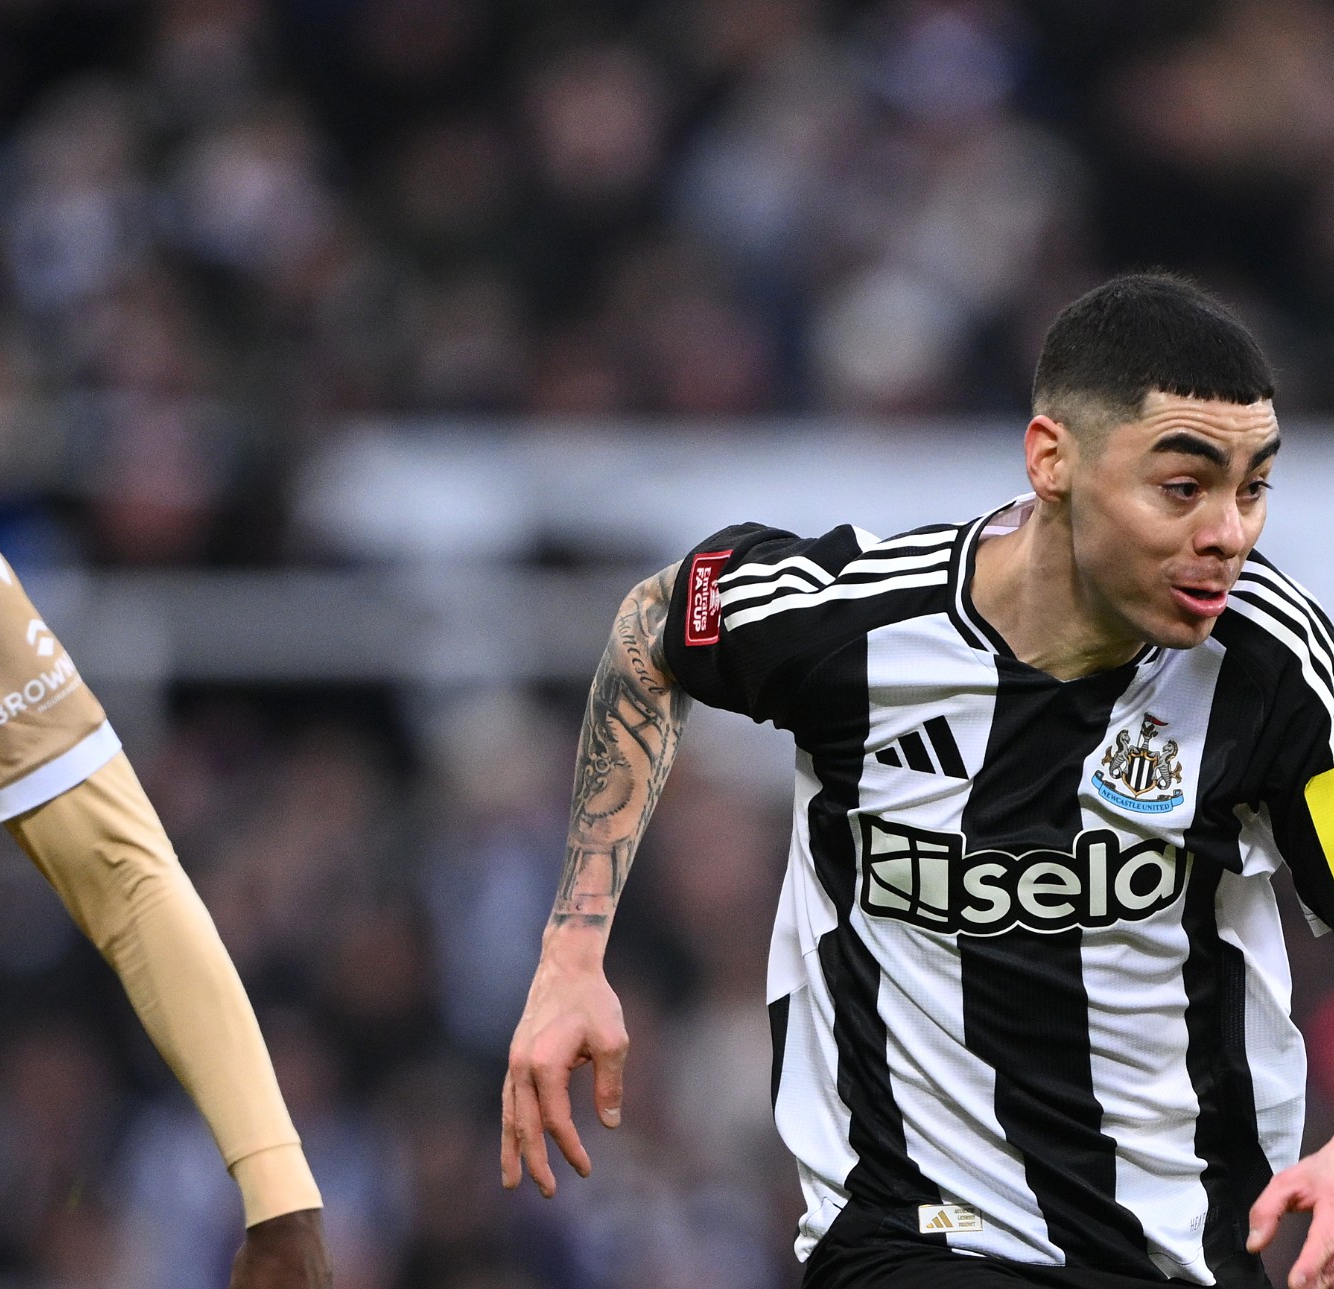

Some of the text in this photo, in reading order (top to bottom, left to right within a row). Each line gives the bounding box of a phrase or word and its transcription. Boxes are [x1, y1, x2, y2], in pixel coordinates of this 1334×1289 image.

[692, 567, 705, 632] FA CUP
[1101, 788, 1170, 811] NEWCASTLE UNITED
[960, 842, 1177, 924] sela
